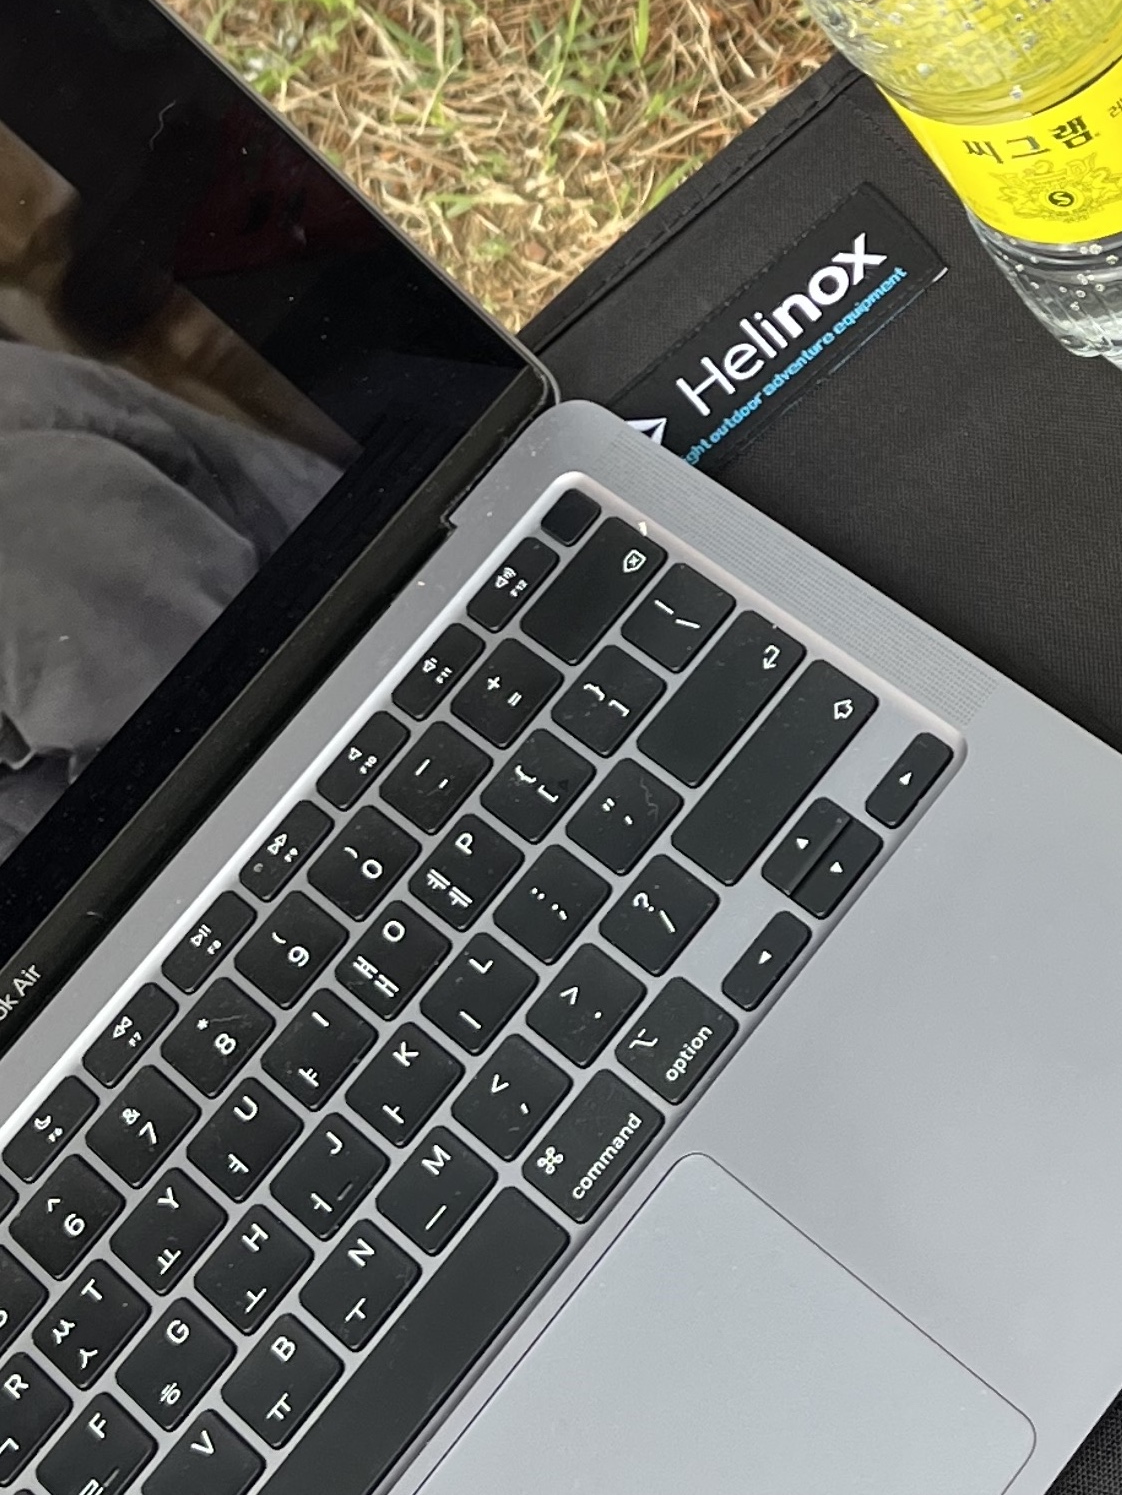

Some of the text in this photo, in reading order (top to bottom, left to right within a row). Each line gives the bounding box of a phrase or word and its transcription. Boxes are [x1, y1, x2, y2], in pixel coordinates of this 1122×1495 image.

[962, 114, 1096, 165] 씨그램
[676, 232, 888, 417] Helinox
[709, 391, 763, 444] outdoor
[762, 331, 836, 397] adventure
[832, 266, 908, 336] equipment
[455, 833, 472, 855] P
[361, 859, 382, 879] 0
[382, 921, 405, 942] O
[288, 946, 309, 967] 9
[469, 959, 493, 974] L
[13, 965, 41, 997] Air
[312, 1012, 329, 1027] I
[214, 1033, 236, 1055] 8
[392, 1042, 419, 1067] K
[665, 1026, 713, 1082] option
[233, 1096, 258, 1121] U
[139, 1122, 156, 1144] 7
[326, 1132, 342, 1154] J
[422, 1145, 451, 1175] M
[572, 1112, 642, 1200] command
[157, 1187, 179, 1209] Y
[64, 1214, 85, 1237] 6
[242, 1224, 268, 1252] H
[348, 1238, 374, 1267] N
[80, 1279, 102, 1301] T
[166, 1320, 189, 1344] G
[271, 1337, 295, 1362] B
[3, 1374, 28, 1400] R
[88, 1413, 106, 1438] F
[191, 1430, 214, 1454] V
